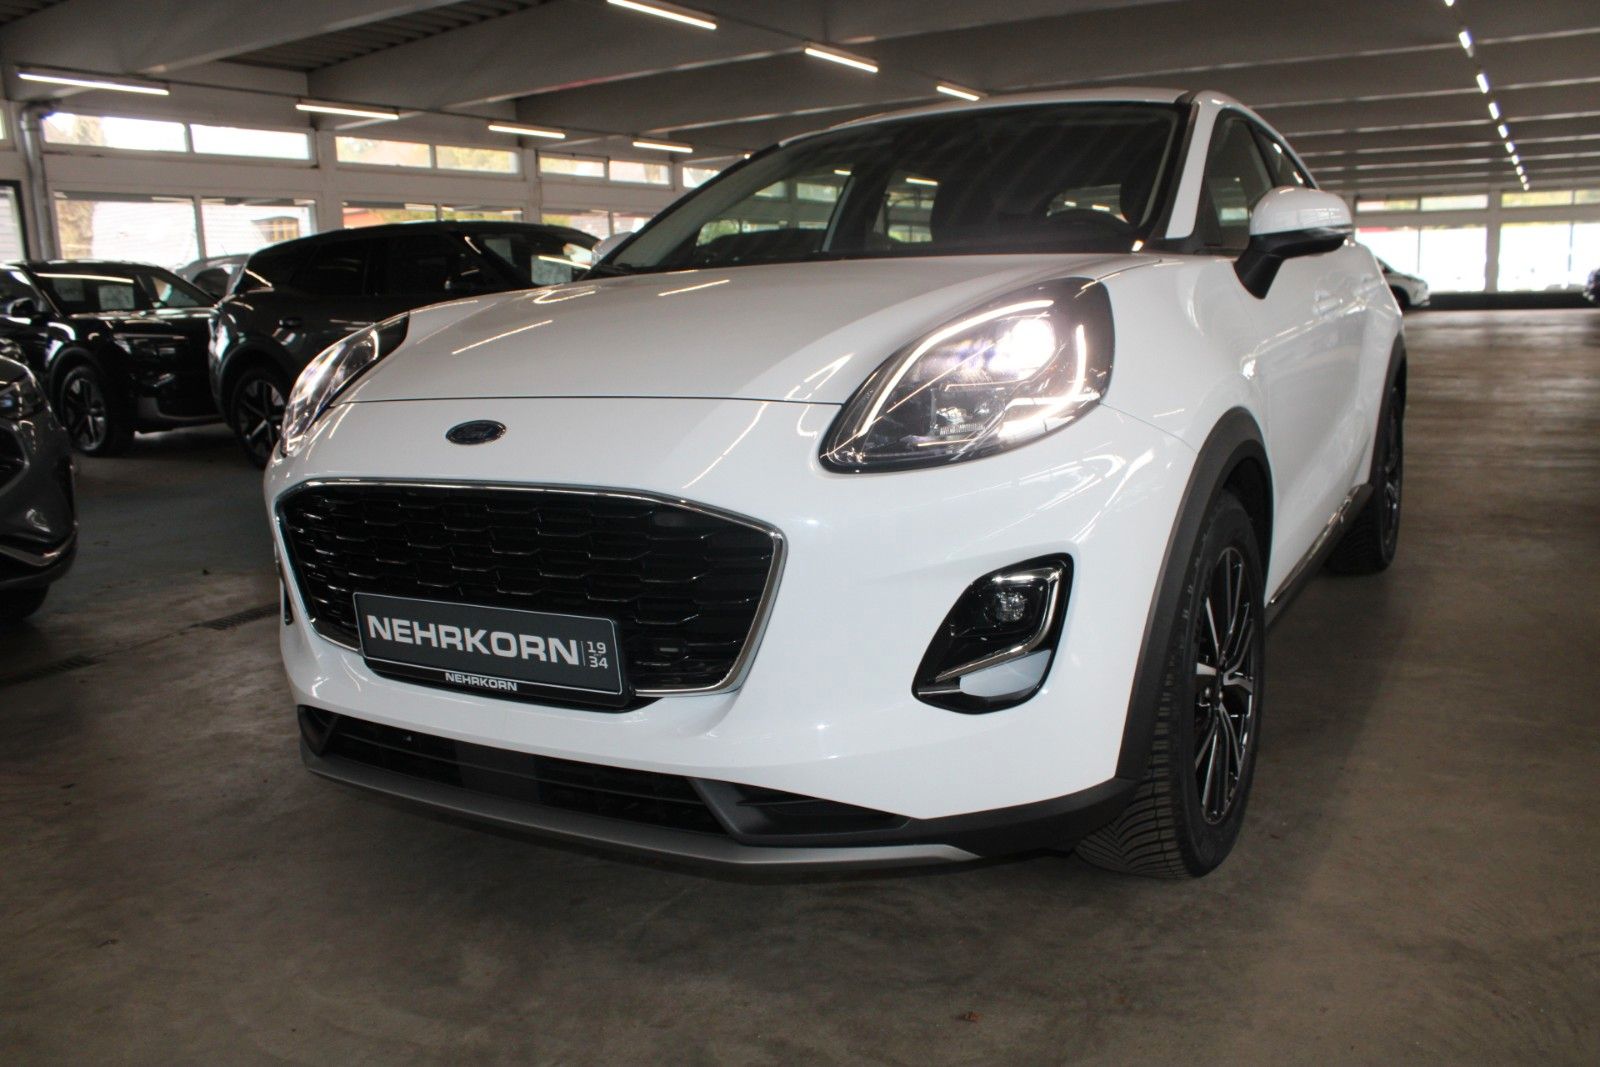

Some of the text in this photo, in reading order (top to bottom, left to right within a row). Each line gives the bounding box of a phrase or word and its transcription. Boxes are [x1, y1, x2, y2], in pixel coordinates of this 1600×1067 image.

[367, 615, 579, 665] NEHRKORN
[586, 641, 607, 654] 19
[589, 656, 608, 669] 34
[445, 672, 518, 691] NEHRKORN
